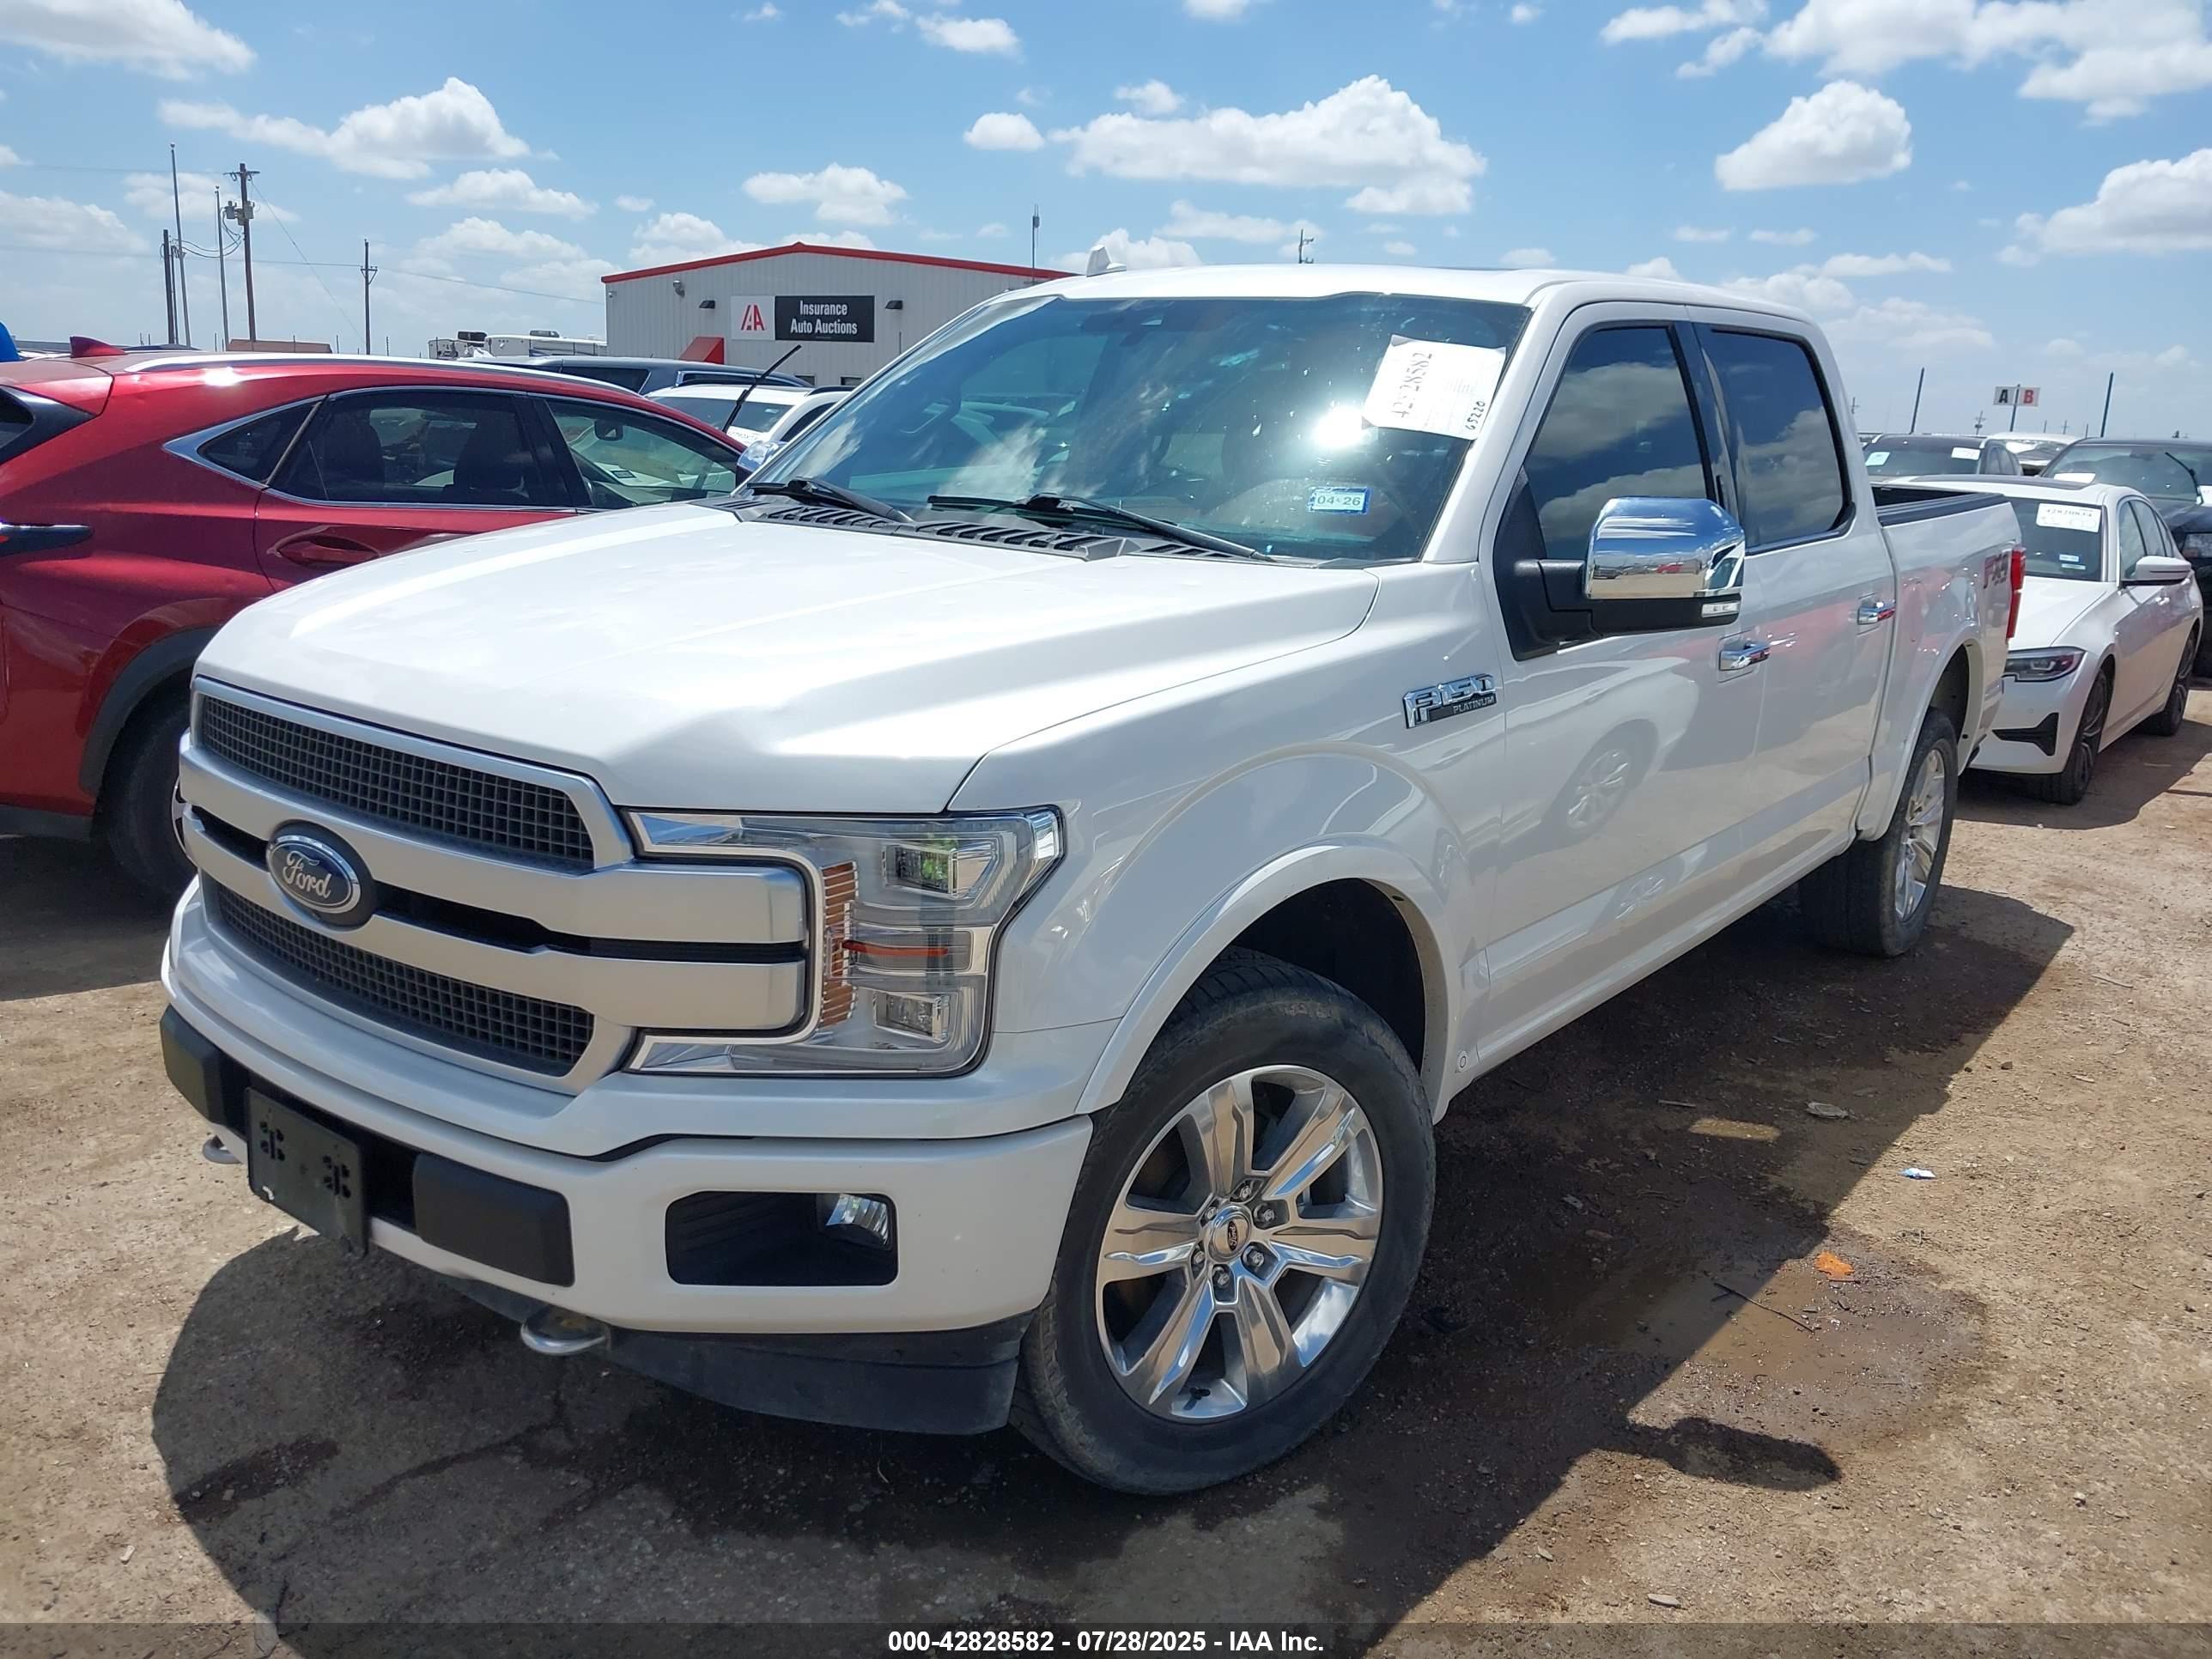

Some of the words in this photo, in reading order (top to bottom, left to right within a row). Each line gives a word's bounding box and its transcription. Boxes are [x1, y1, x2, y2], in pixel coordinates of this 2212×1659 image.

[799, 300, 848, 316] Insurance
[790, 319, 812, 334] Auto
[815, 319, 858, 335] Auctions
[1998, 389, 2008, 404] A
[2023, 389, 2034, 404] B
[1453, 696, 1496, 714] PLATINUM
[283, 850, 332, 898] Ford
[1228, 1225, 1237, 1246] Ford
